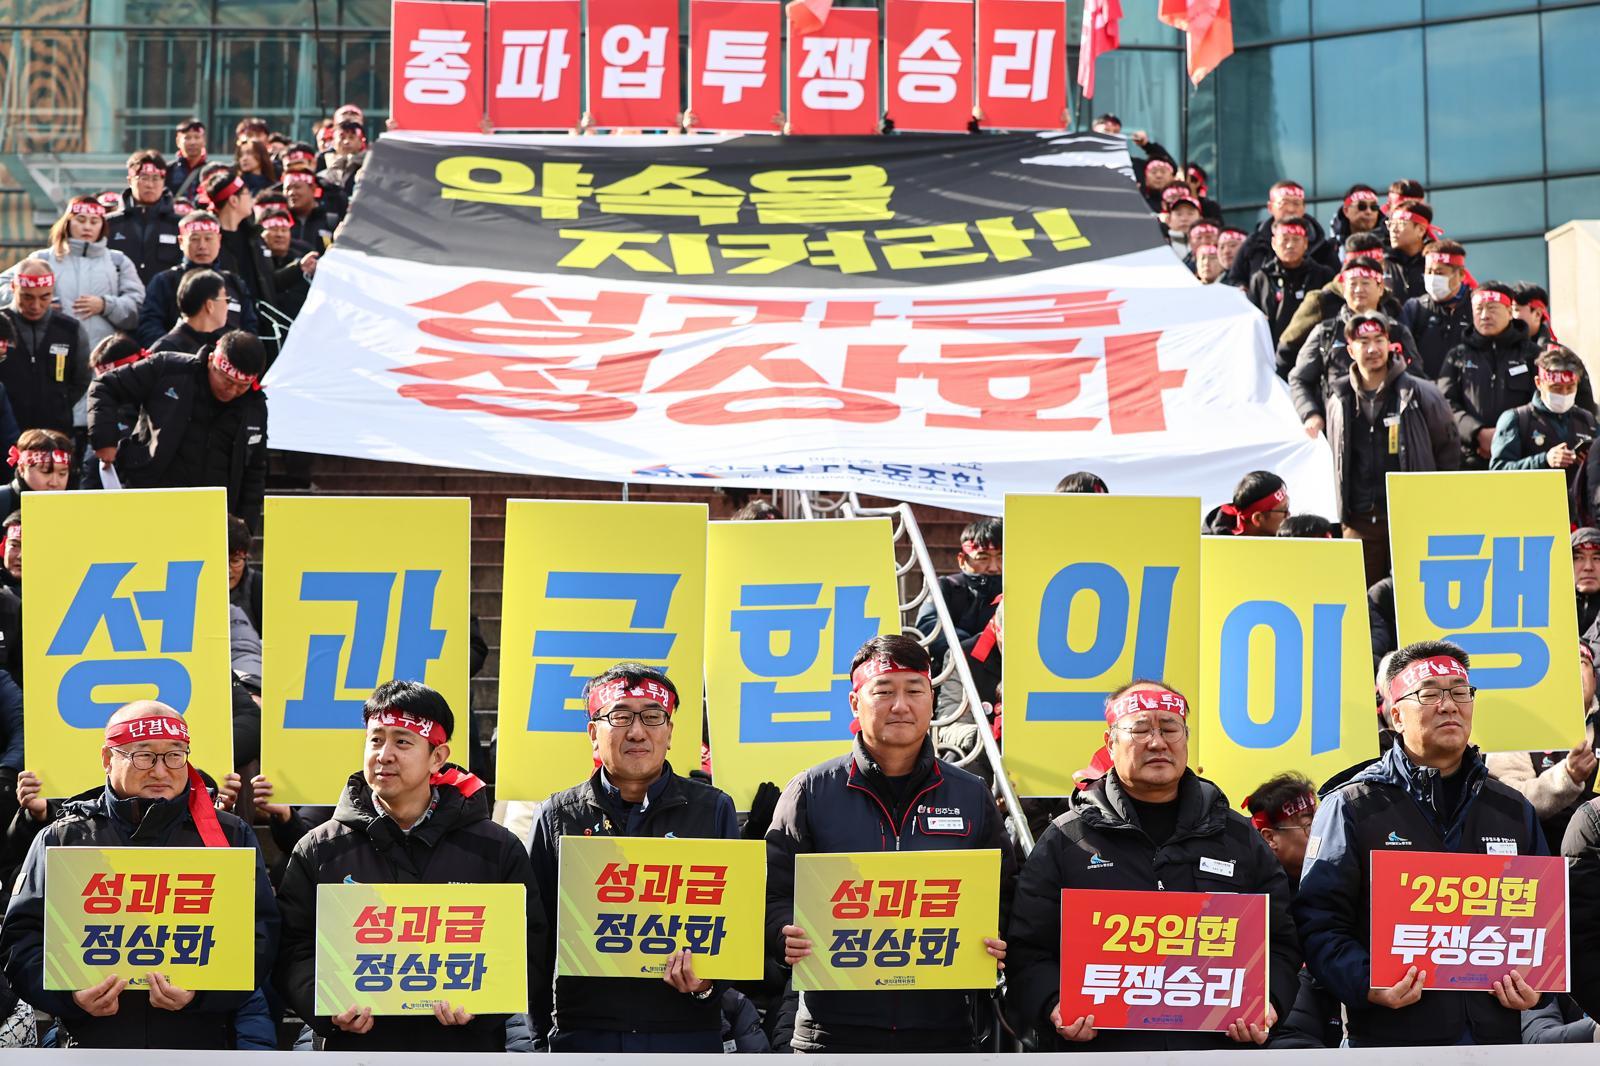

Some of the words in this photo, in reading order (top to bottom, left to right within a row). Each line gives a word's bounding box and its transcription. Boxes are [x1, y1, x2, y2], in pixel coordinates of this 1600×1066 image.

[403, 29, 471, 105] 총
[496, 29, 571, 102] 파
[601, 25, 669, 99] 업
[702, 30, 769, 104] 투
[798, 37, 871, 111] 쟁
[897, 28, 962, 104] 승
[988, 30, 1055, 102] 리
[436, 157, 895, 225] 약속을
[557, 208, 1092, 275] 지켜라!
[386, 330, 1188, 435] 정상화
[47, 560, 204, 729] 성
[283, 569, 447, 729] 과
[527, 571, 681, 732] 급
[730, 583, 880, 743] 합
[1025, 562, 1180, 721] 의
[1219, 600, 1345, 755] 이
[1419, 534, 1555, 690] 행
[129, 718, 163, 738] 단결
[81, 873, 216, 914] 성과급
[595, 863, 728, 905] 성과급
[830, 879, 962, 919] 성과급
[1400, 872, 1539, 918] '25임협
[81, 925, 216, 966] 정상화
[353, 906, 486, 944] 성과급
[594, 913, 727, 956] 정상화
[1092, 911, 1239, 957] '25임협
[1391, 924, 1547, 968] 투쟁승리
[829, 928, 960, 968] 정상화
[353, 953, 487, 992] 정상화
[1081, 964, 1247, 1008] 투쟁승리
